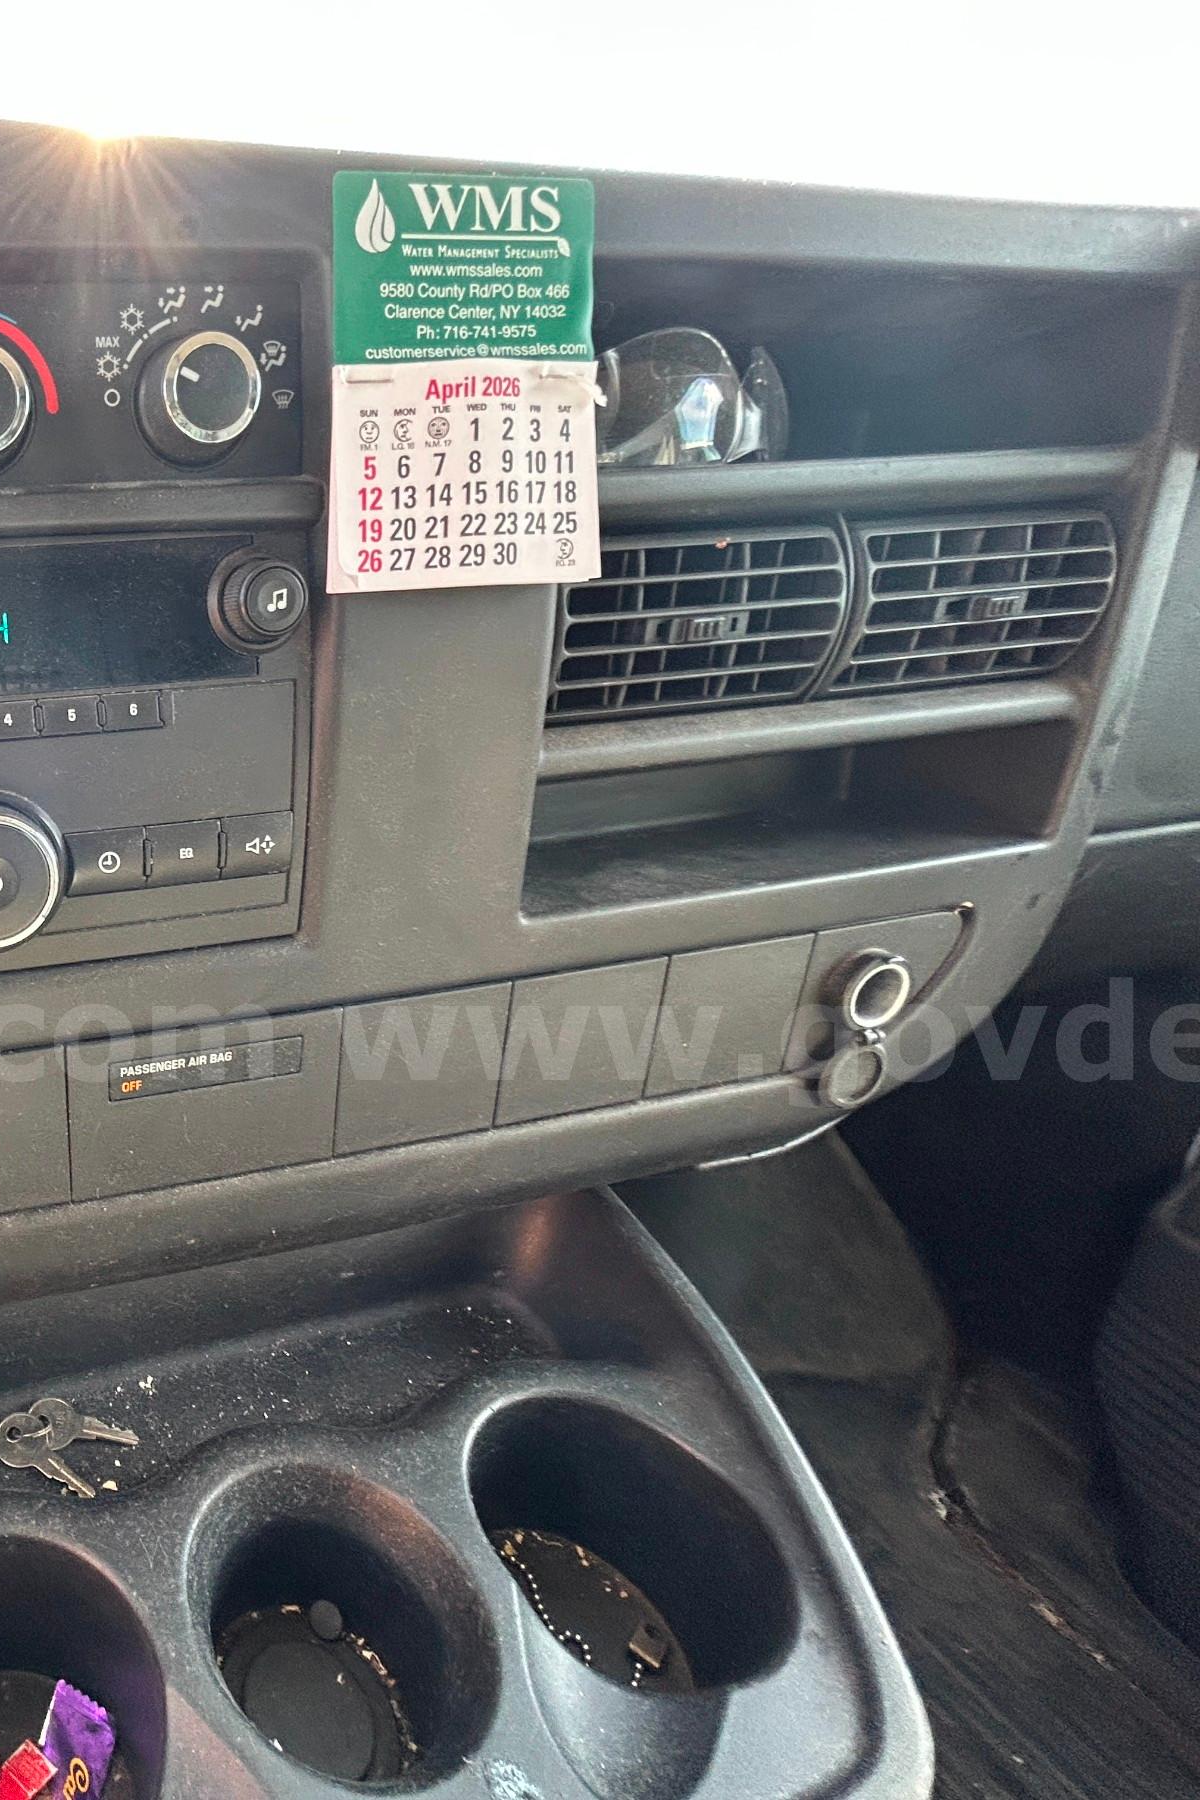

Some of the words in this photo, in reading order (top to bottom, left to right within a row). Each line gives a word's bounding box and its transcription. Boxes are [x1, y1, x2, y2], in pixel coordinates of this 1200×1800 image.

[408, 183, 561, 233] WMS
[409, 264, 543, 278] www.wmssales.com
[379, 283, 415, 299] 9580
[417, 282, 465, 302] County
[469, 283, 514, 299] Rd/PO
[517, 284, 542, 299] Box
[545, 284, 570, 299] 466
[384, 304, 445, 319] Clarence
[448, 304, 497, 321] Center,
[499, 305, 521, 319] NY
[524, 304, 567, 318] 14032
[95, 336, 119, 348] MAX
[416, 325, 441, 340] Ph:
[443, 325, 537, 340] 716-741-9575
[365, 343, 588, 360] customerservice@wmssales.com
[425, 376, 476, 404] April
[482, 376, 521, 398] 2026
[359, 409, 379, 418] SUN
[393, 407, 417, 417] MON
[431, 405, 452, 414] TUE
[466, 403, 488, 412] WED
[500, 403, 517, 412] THU
[529, 404, 541, 413] FRI
[557, 404, 572, 413] SAT
[469, 418, 480, 442] 1
[502, 417, 514, 441] 2
[530, 418, 541, 442] 3
[559, 418, 571, 442] 4
[363, 456, 377, 480] 5
[397, 455, 410, 478] 6
[433, 453, 446, 477] 7
[468, 450, 482, 474] 8
[501, 450, 513, 473] 9
[526, 451, 546, 474] 10
[553, 450, 574, 474] 11
[358, 487, 383, 511] 12
[391, 486, 417, 510] 13
[425, 483, 453, 507] 14
[462, 481, 488, 505] 15
[496, 481, 518, 503] 16
[525, 481, 546, 504] 17
[553, 480, 576, 503] 18
[358, 519, 383, 543] 19
[390, 518, 417, 542] 20
[425, 515, 450, 539] 21
[460, 513, 487, 536] 22
[494, 512, 518, 535] 23
[524, 512, 546, 535] 24
[553, 511, 577, 534] 25
[358, 549, 382, 573] 26
[390, 548, 416, 571] 27
[424, 546, 451, 569] 28
[459, 543, 486, 567] 29
[493, 542, 518, 565] 30
[3, 713, 13, 726] 4
[67, 708, 77, 722] 5
[129, 703, 138, 717] 6
[179, 847, 194, 860] EQ
[120, 1058, 186, 1078] PASSENGER
[187, 1054, 208, 1068] AIR
[209, 1051, 233, 1064] BAG
[121, 1080, 143, 1093] OFF
